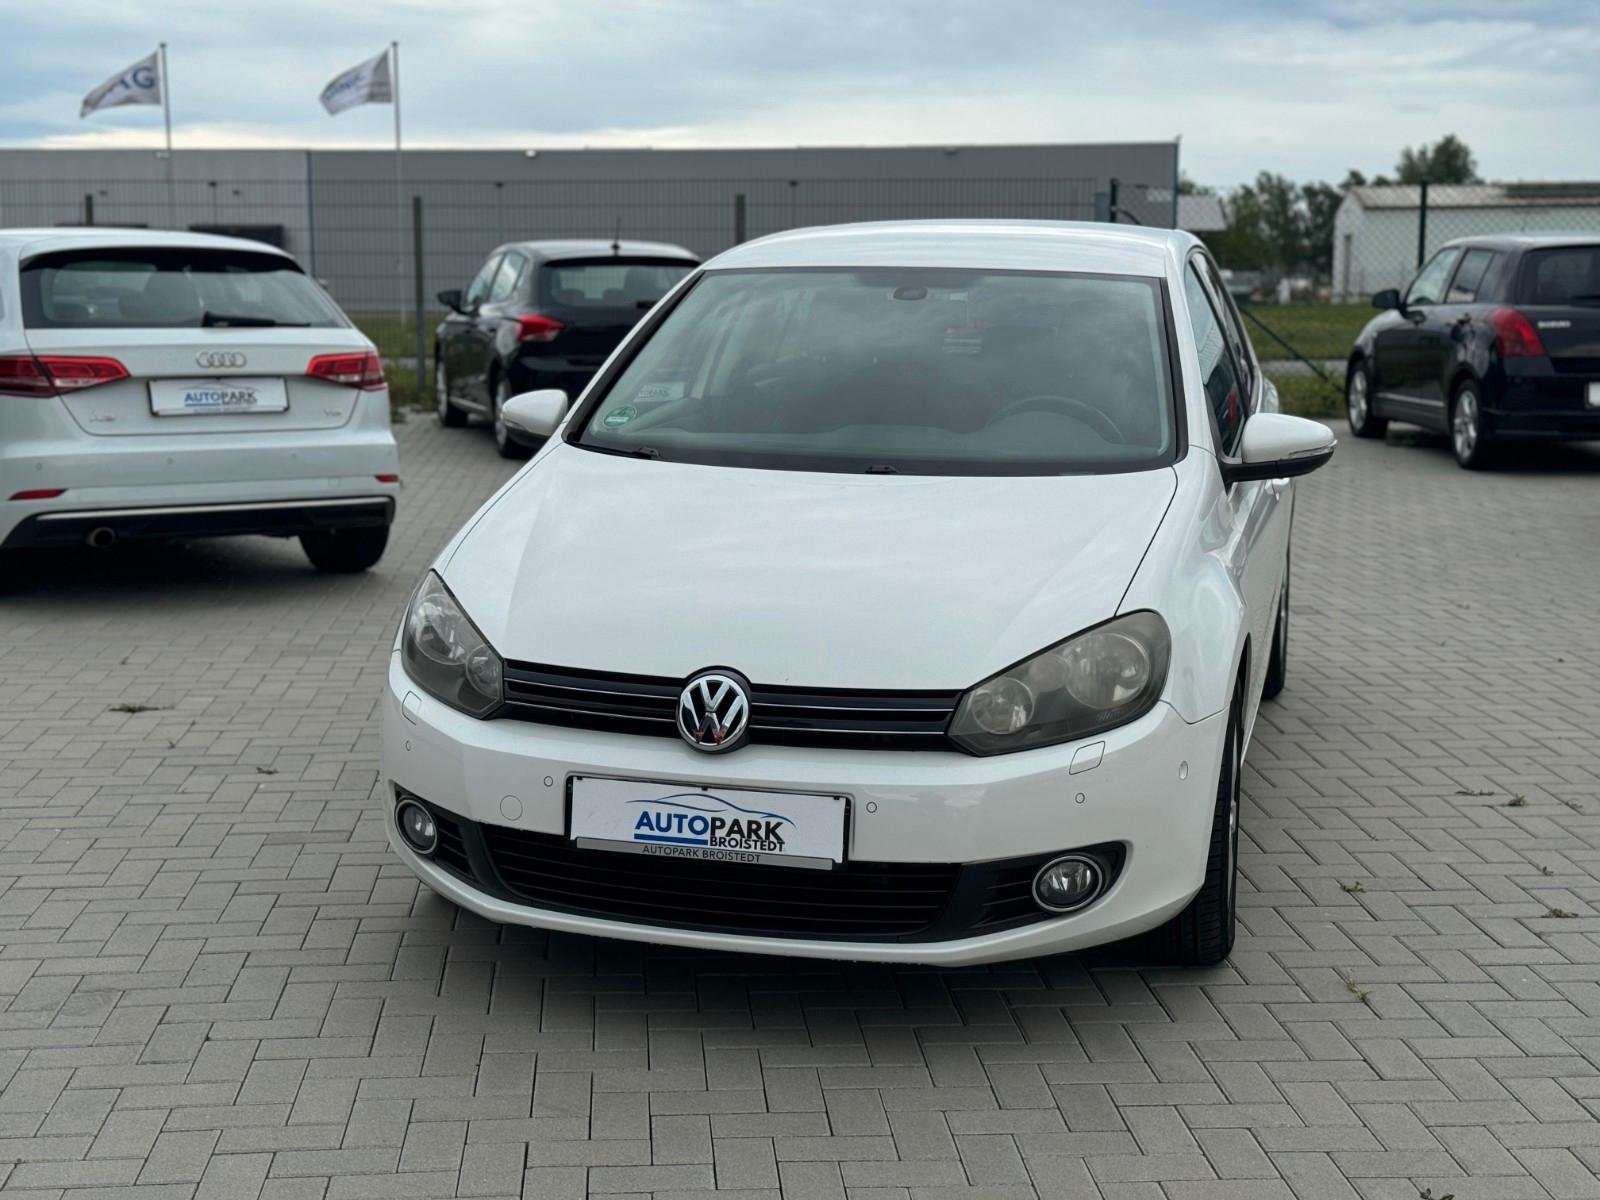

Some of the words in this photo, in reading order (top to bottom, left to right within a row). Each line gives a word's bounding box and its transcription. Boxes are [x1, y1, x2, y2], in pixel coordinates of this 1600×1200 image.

[185, 391, 256, 402] AUTOPARK
[635, 811, 784, 841] AUTOPARK
[709, 836, 785, 852] BROISTEDT
[642, 845, 699, 858] AUTOPARK
[702, 850, 762, 863] BROISTEDT
